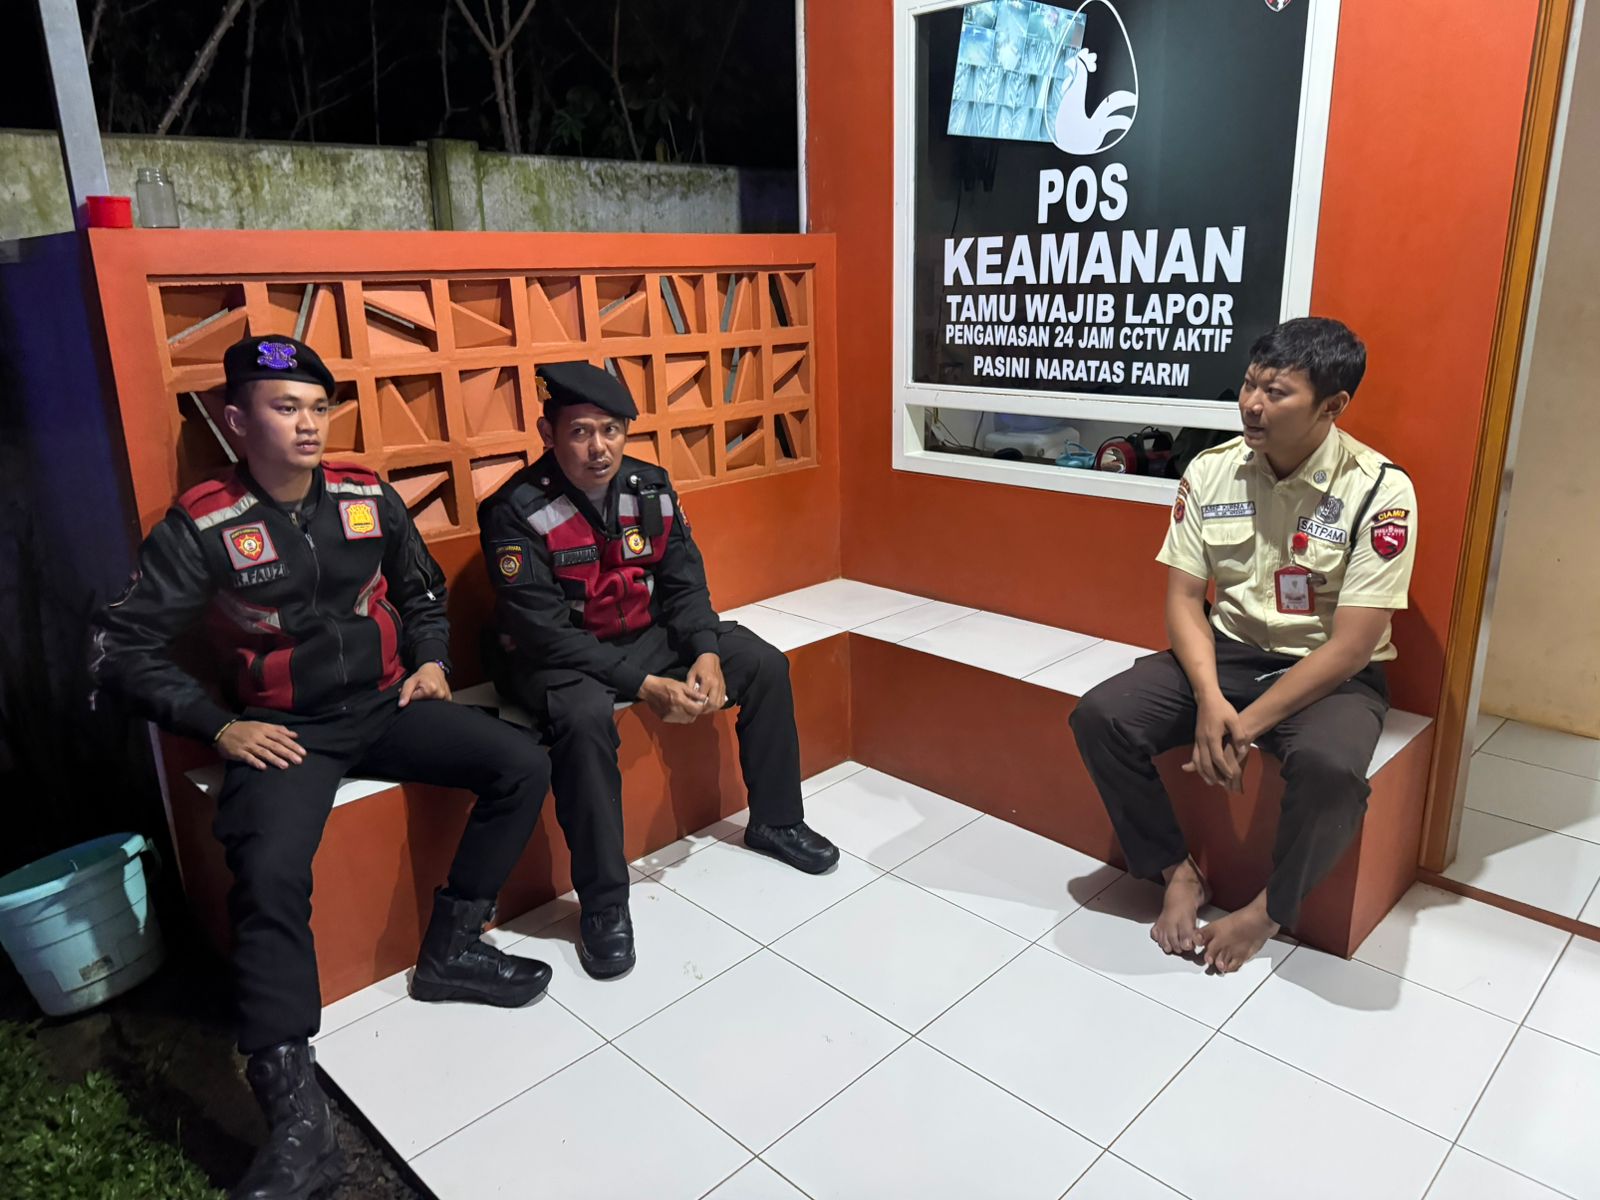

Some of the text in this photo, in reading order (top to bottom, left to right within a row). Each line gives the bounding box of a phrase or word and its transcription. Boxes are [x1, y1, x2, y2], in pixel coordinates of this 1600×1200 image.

[1037, 162, 1128, 224] POS
[943, 226, 1246, 286] KEAMANAN
[946, 292, 1234, 326] TAMU WAJIB LAPOR
[945, 324, 1233, 353] PENGAWASAN 24 JAM CCTV AKTIF
[973, 355, 1190, 387] PASINI NARATAS FARM
[1301, 519, 1344, 542] SATPAM
